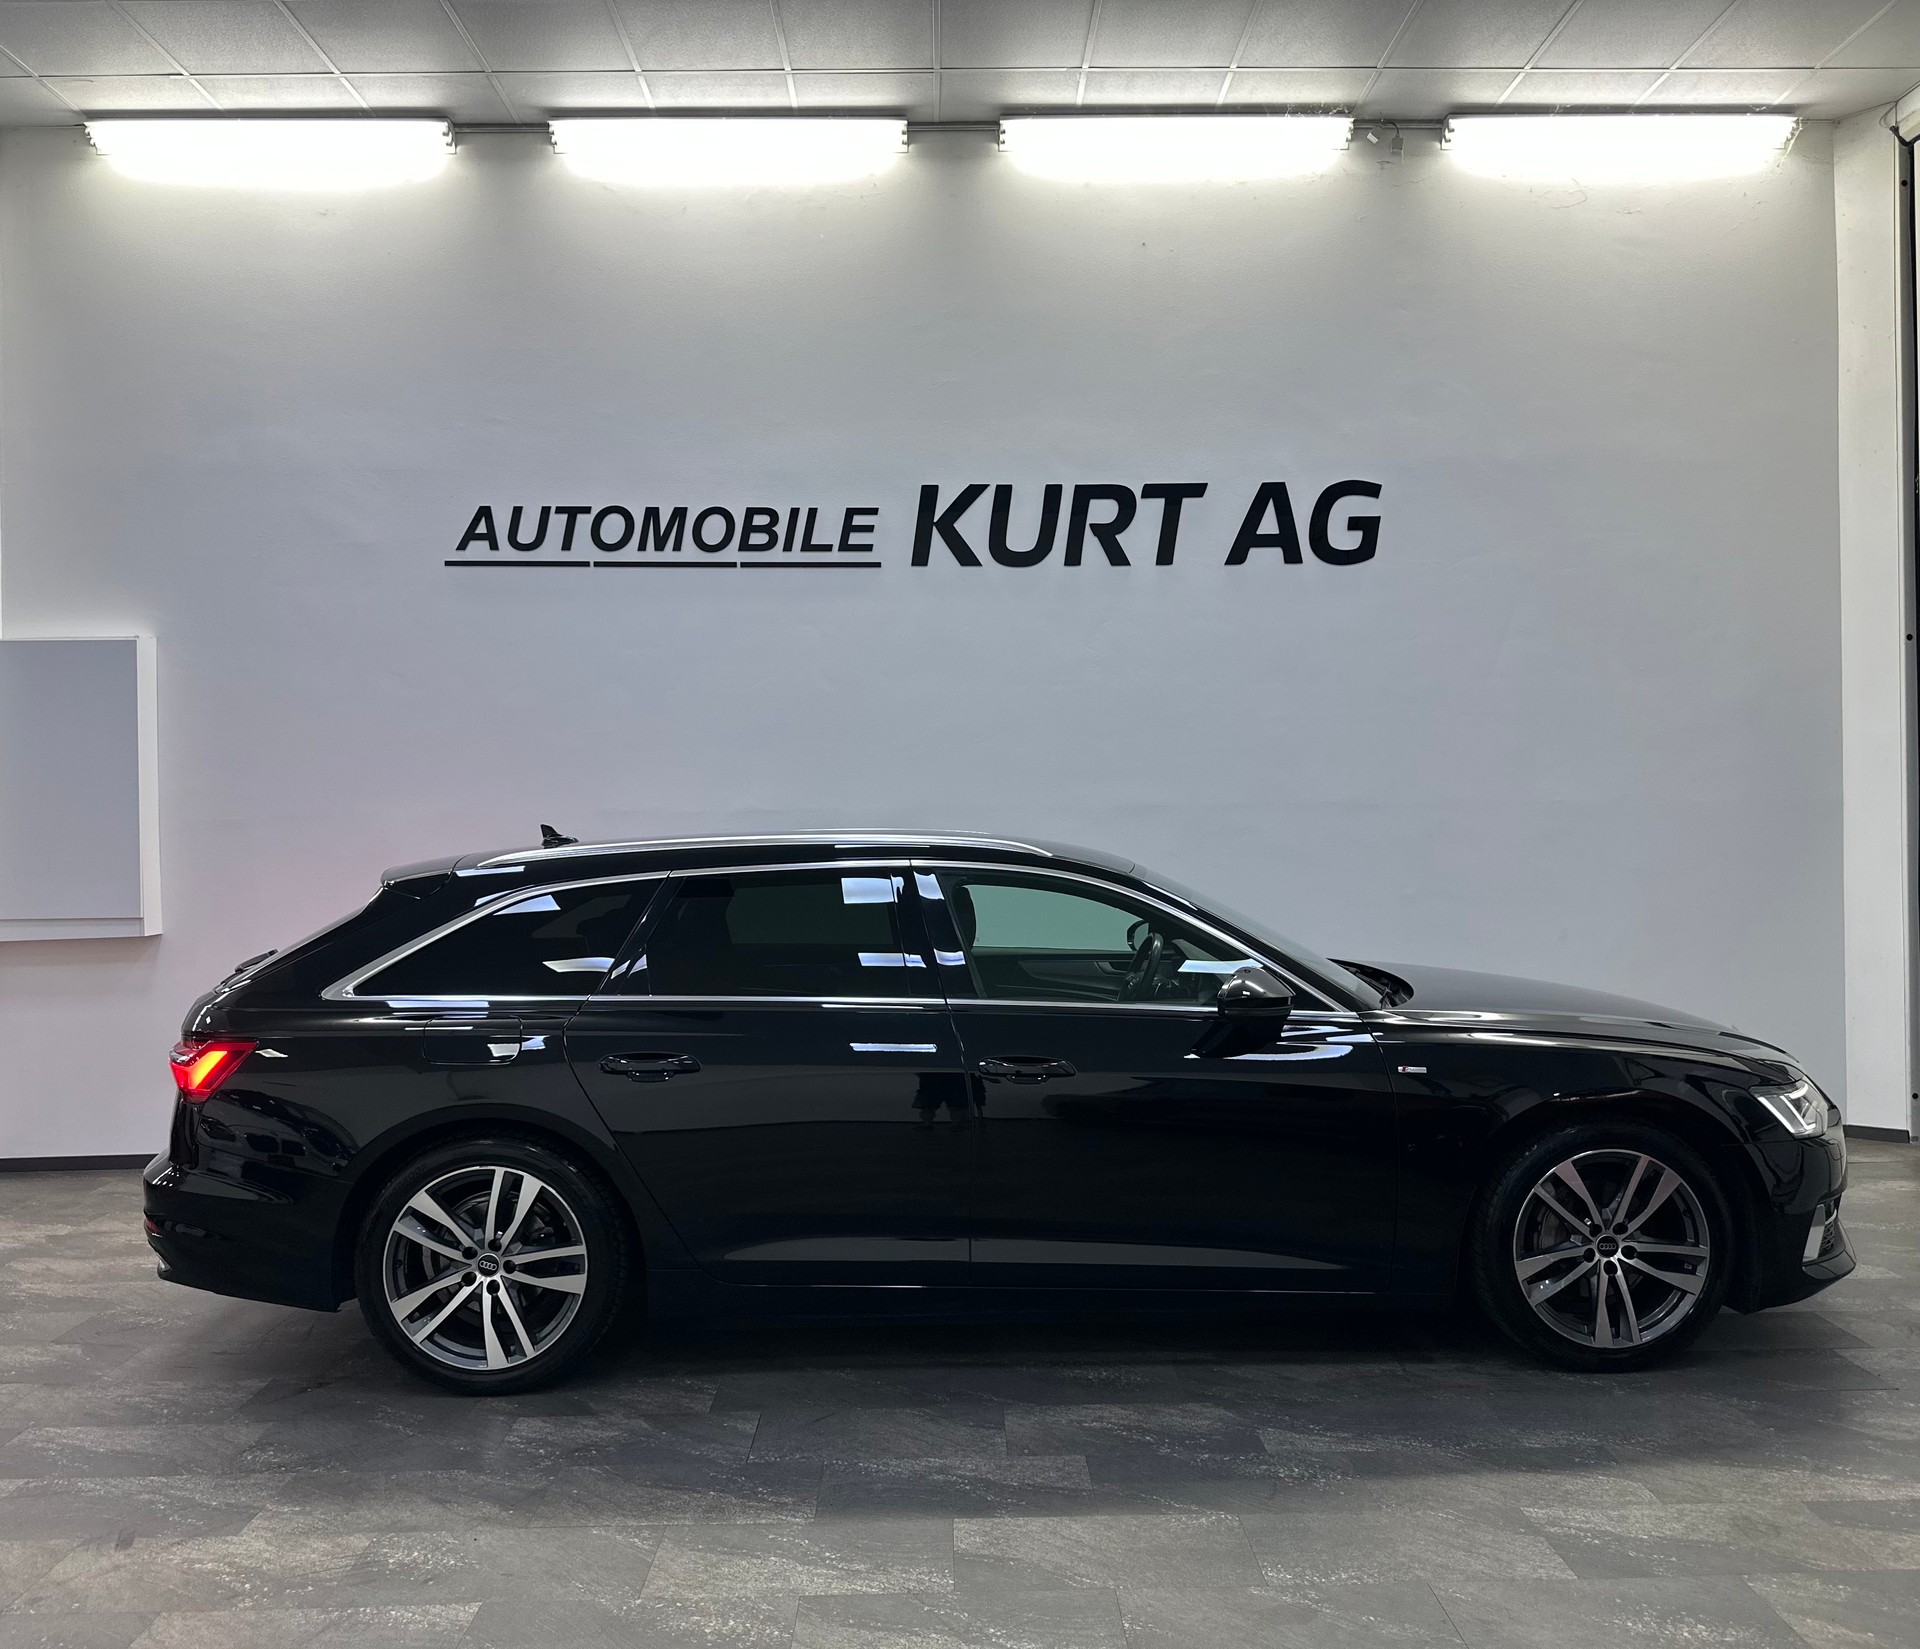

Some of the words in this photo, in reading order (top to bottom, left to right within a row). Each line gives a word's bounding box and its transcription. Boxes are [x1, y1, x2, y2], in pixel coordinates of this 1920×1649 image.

[455, 505, 880, 553] AUTOMOBILE
[910, 482, 1208, 568] KURT
[1223, 479, 1383, 567] AG
